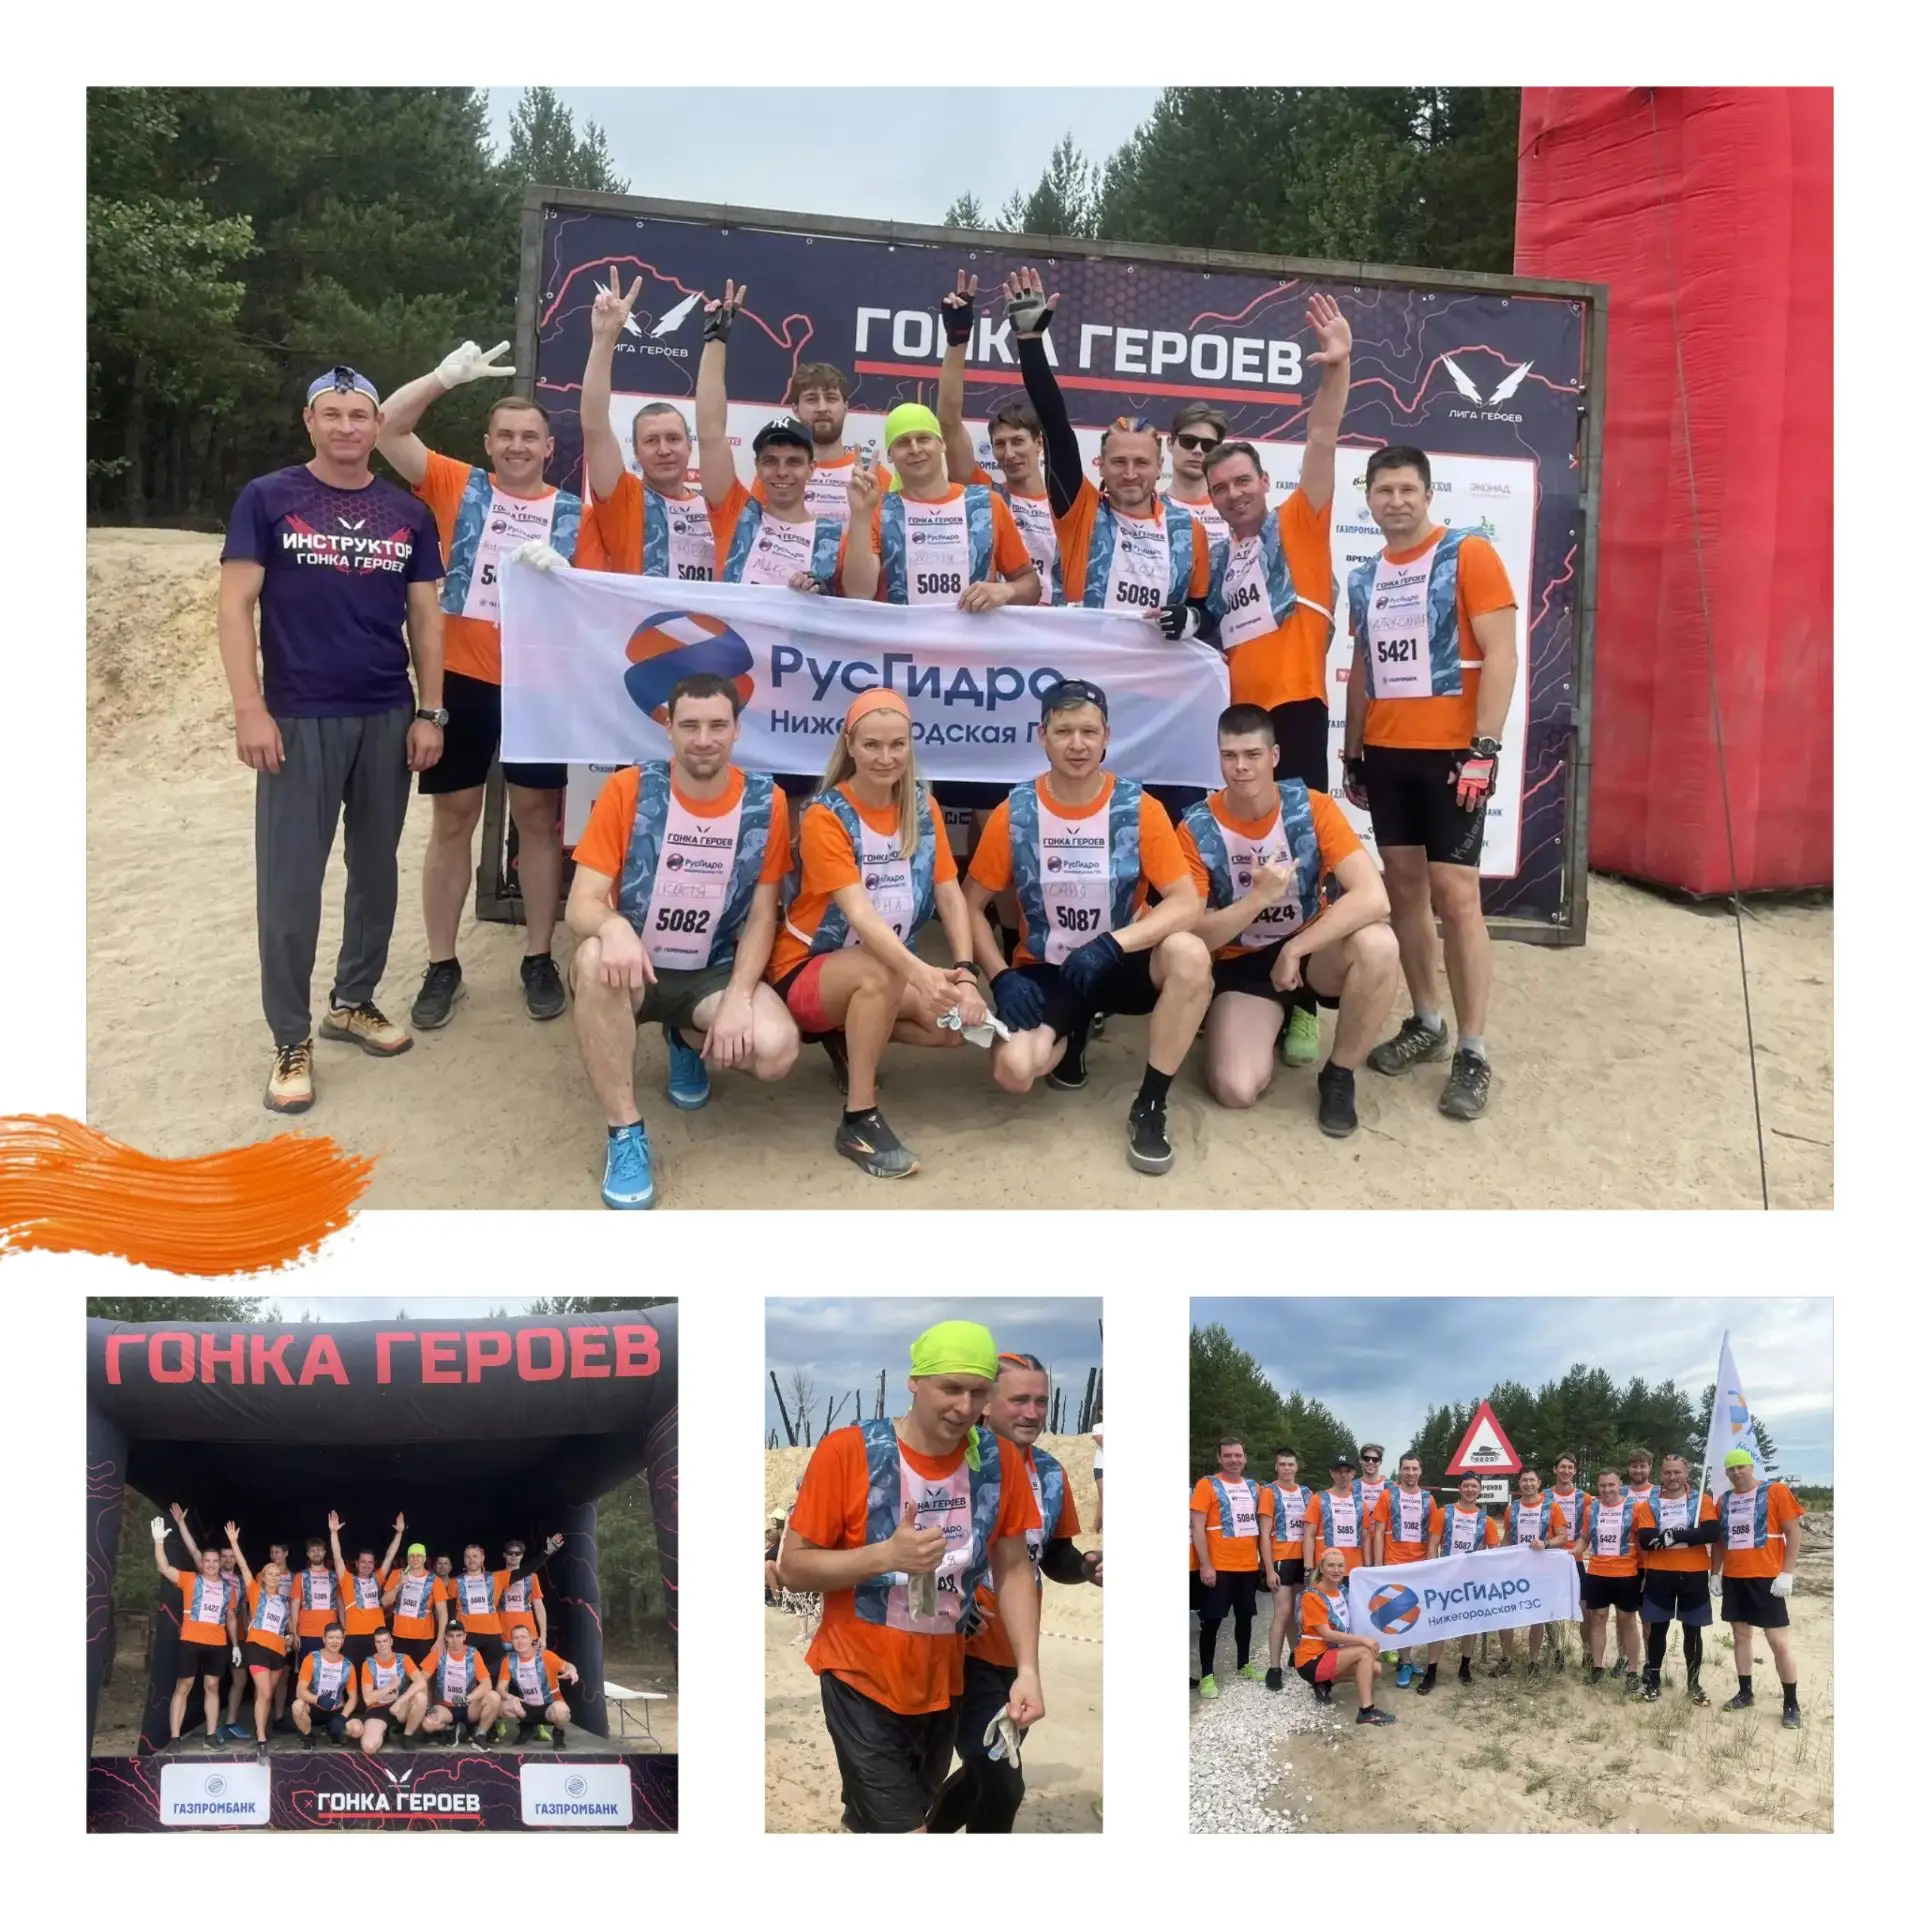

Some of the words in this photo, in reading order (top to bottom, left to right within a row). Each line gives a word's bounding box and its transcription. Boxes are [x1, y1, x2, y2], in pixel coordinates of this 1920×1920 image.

[612, 343, 636, 353] ИГА
[640, 345, 689, 358] ГЕРОЕВ
[1079, 323, 1304, 386] ГЕРОЕВ
[1449, 409, 1478, 420] ЛИГА
[1481, 412, 1523, 423] ГЕРОЕВ
[908, 516, 934, 524] ГОНКА
[935, 516, 963, 524] ГЕРОЕВ
[282, 532, 413, 559] ИНСТРУКТОР
[296, 552, 350, 567] ГОНКА
[353, 556, 406, 573] ГЕРОЕВ
[917, 573, 962, 594] 5088
[1375, 579, 1399, 590] ГОНКА
[1400, 574, 1427, 586] ГЕРОЕВ
[1116, 581, 1161, 608] 5089
[1377, 638, 1418, 663] 5421
[770, 644, 1065, 712] РусГидро
[667, 833, 698, 844] ГОНКА
[700, 838, 733, 847] ГЕРОЕВ
[1043, 838, 1071, 846] ГОНКА
[1072, 838, 1105, 846] ГЕРОЕВ
[684, 859, 724, 870] РусГидро
[1063, 860, 1100, 869] РусГидро
[1232, 855, 1252, 863] ГОНК
[655, 908, 711, 934] 5082
[1056, 905, 1101, 932] 5087
[105, 1331, 350, 1386] ГОНКА
[374, 1324, 662, 1385] ГЕРОЕВ
[1236, 1513, 1255, 1523] 5084
[1337, 1525, 1355, 1535] 5085
[1731, 1524, 1750, 1535] 5088
[1454, 1540, 1472, 1550] 5087
[1599, 1534, 1617, 1543] 5422
[1424, 1578, 1531, 1610] РусГидро
[1428, 1603, 1518, 1628] Нижегородская
[1519, 1598, 1542, 1613] ГЭС
[174, 1802, 256, 1814] ГАЗПРОМБАНК
[317, 1792, 391, 1811] ГОНКА
[396, 1793, 481, 1812] ГЕРОЕВ
[535, 1803, 619, 1815] ГАЗПРОМБАНК
